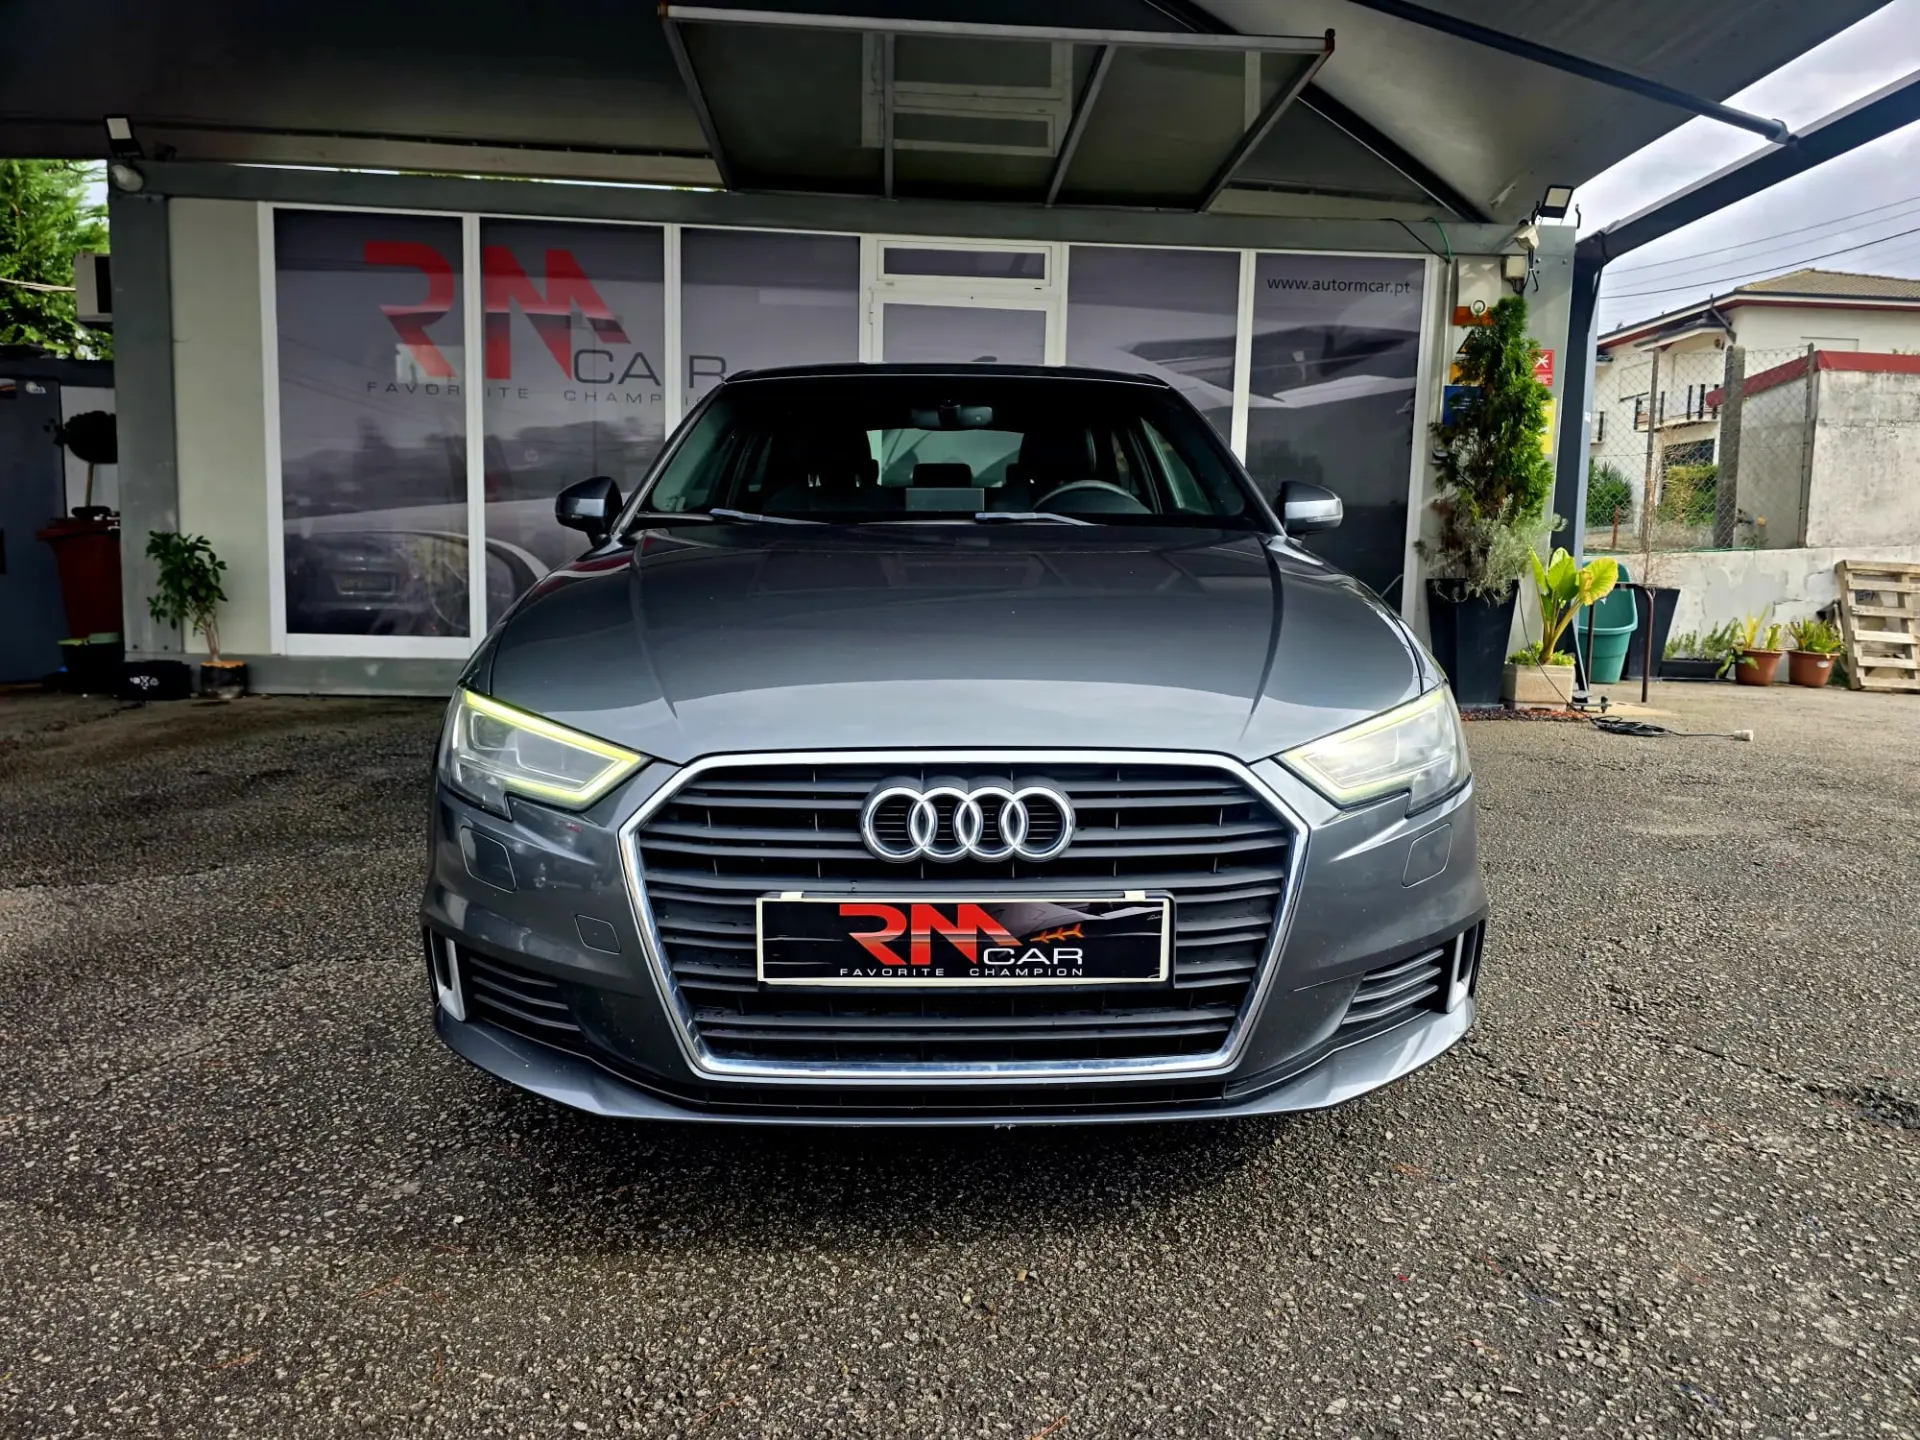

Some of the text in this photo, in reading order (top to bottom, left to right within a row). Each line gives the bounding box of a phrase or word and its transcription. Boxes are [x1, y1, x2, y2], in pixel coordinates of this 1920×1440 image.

[1267, 278, 1411, 297] www.autormcar.pt
[364, 240, 726, 388] RM CAR
[367, 381, 708, 407] FAVORITE CHAMPI
[839, 903, 1083, 966] RM CAR
[840, 967, 1083, 977] FAVORITE CHAMPION
